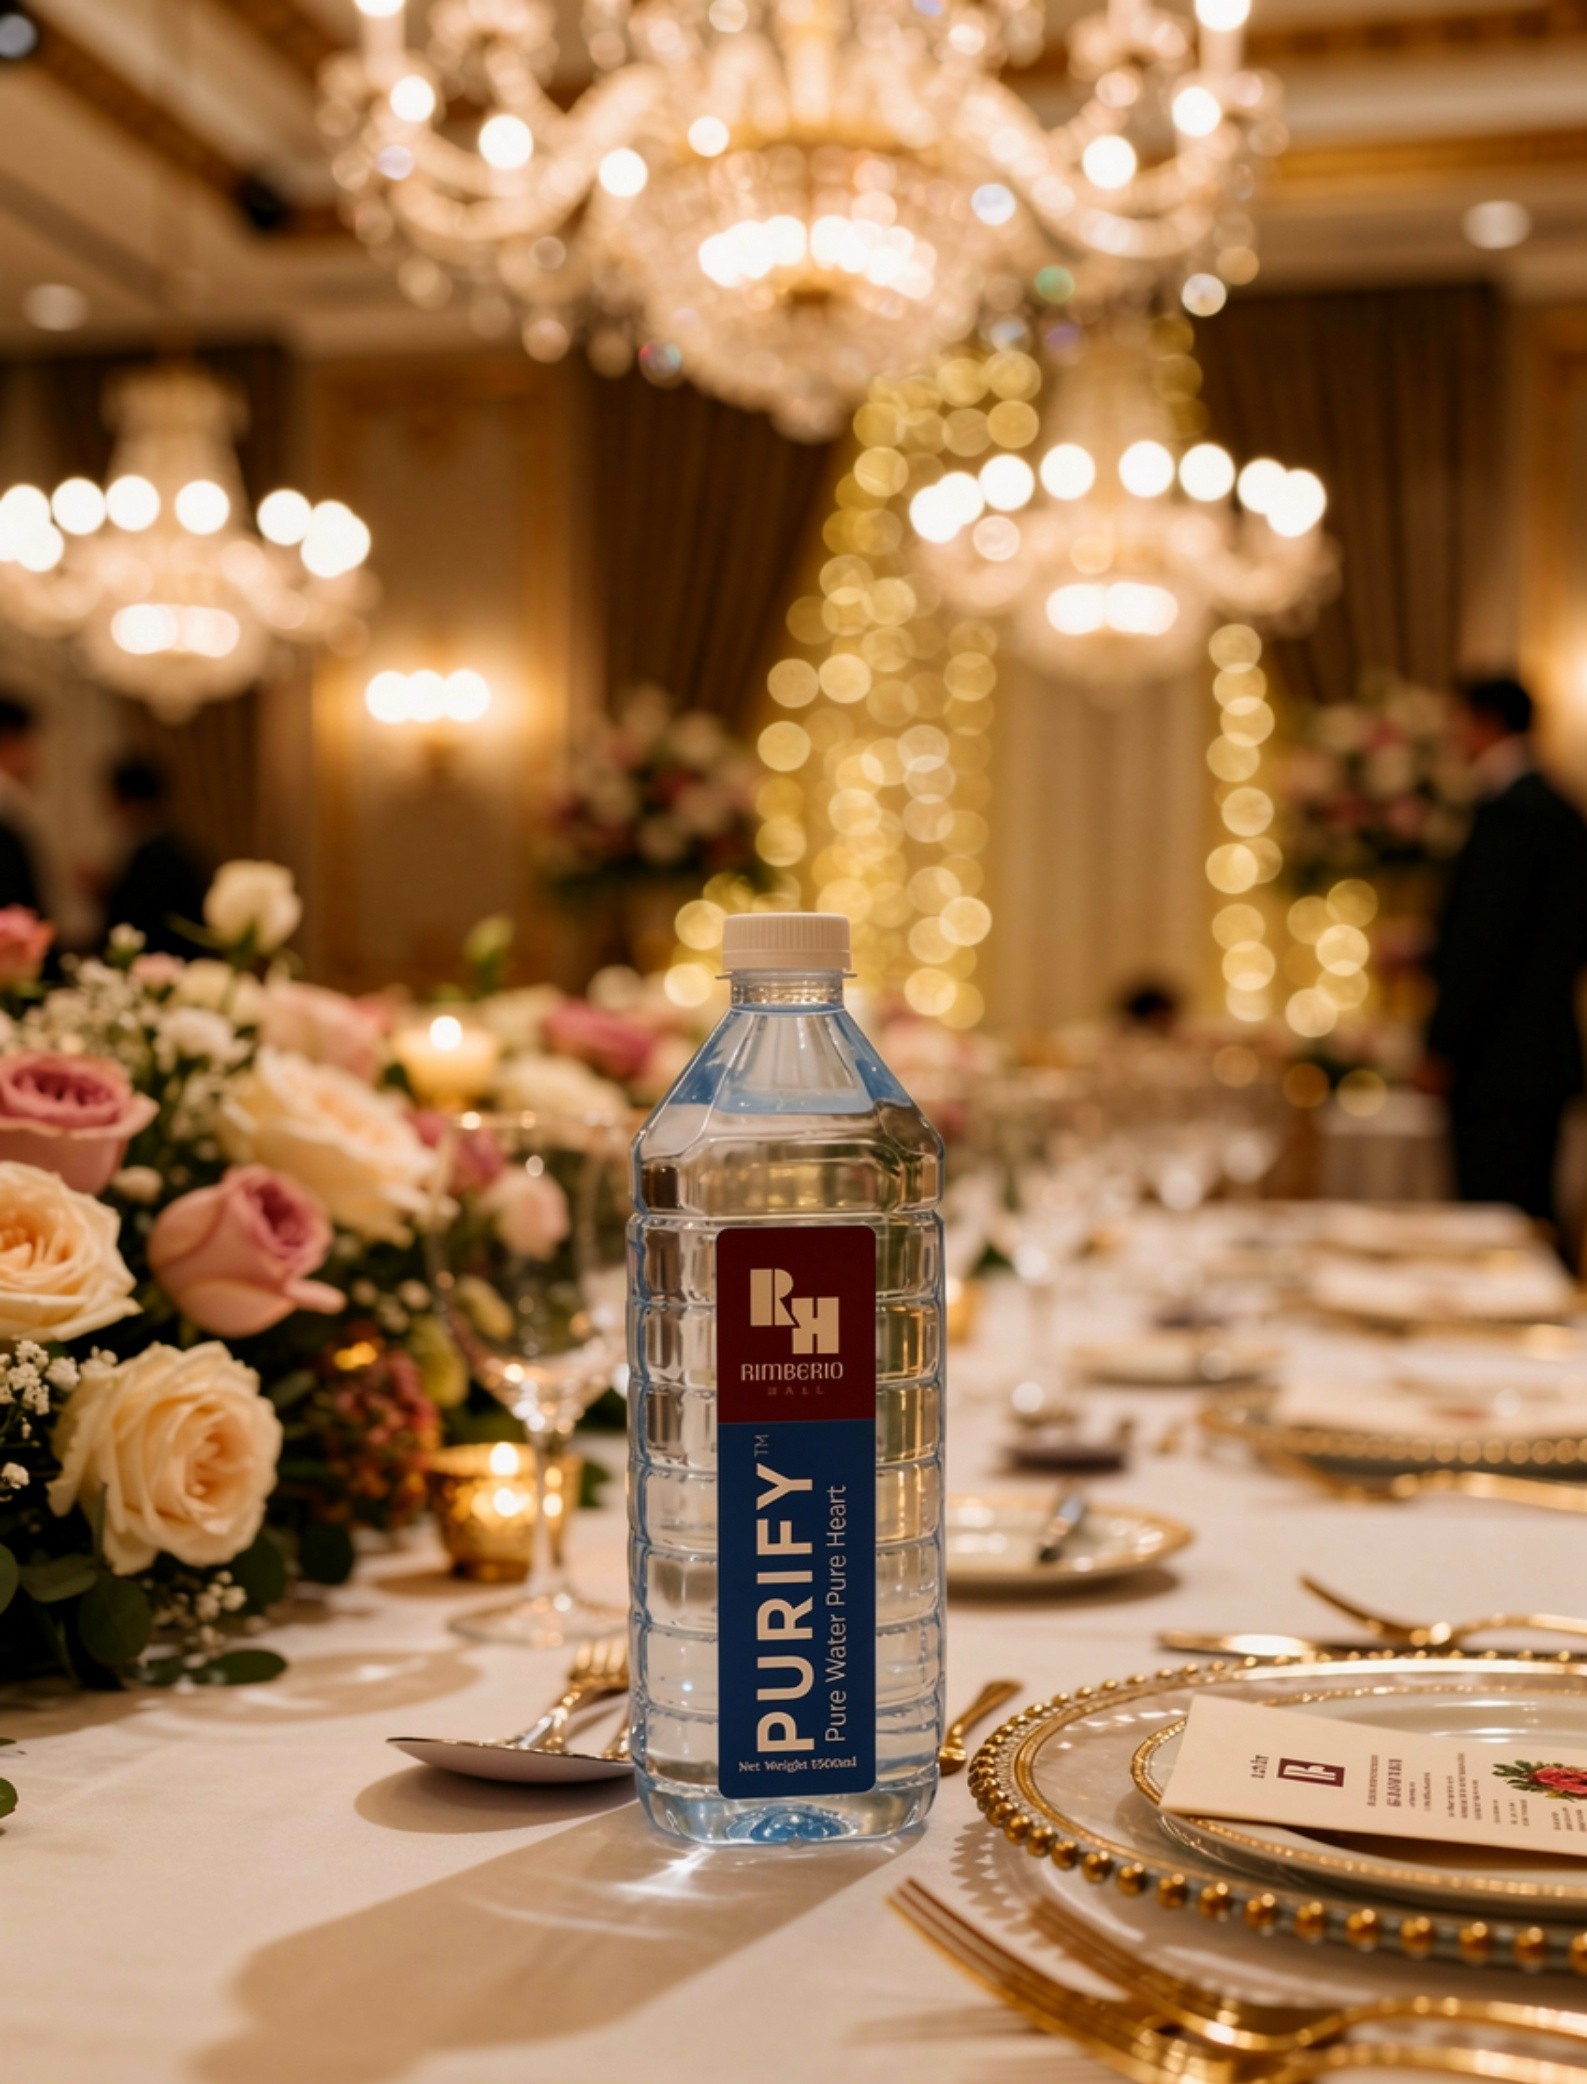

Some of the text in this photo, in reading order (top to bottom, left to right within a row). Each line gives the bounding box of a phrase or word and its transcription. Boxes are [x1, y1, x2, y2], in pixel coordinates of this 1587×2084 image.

[741, 1362, 843, 1381] RIMBERIO
[756, 1463, 815, 1752] PURIFY
[825, 1484, 847, 1742] Pure Water Pure Heart
[738, 1760, 760, 1773] Net
